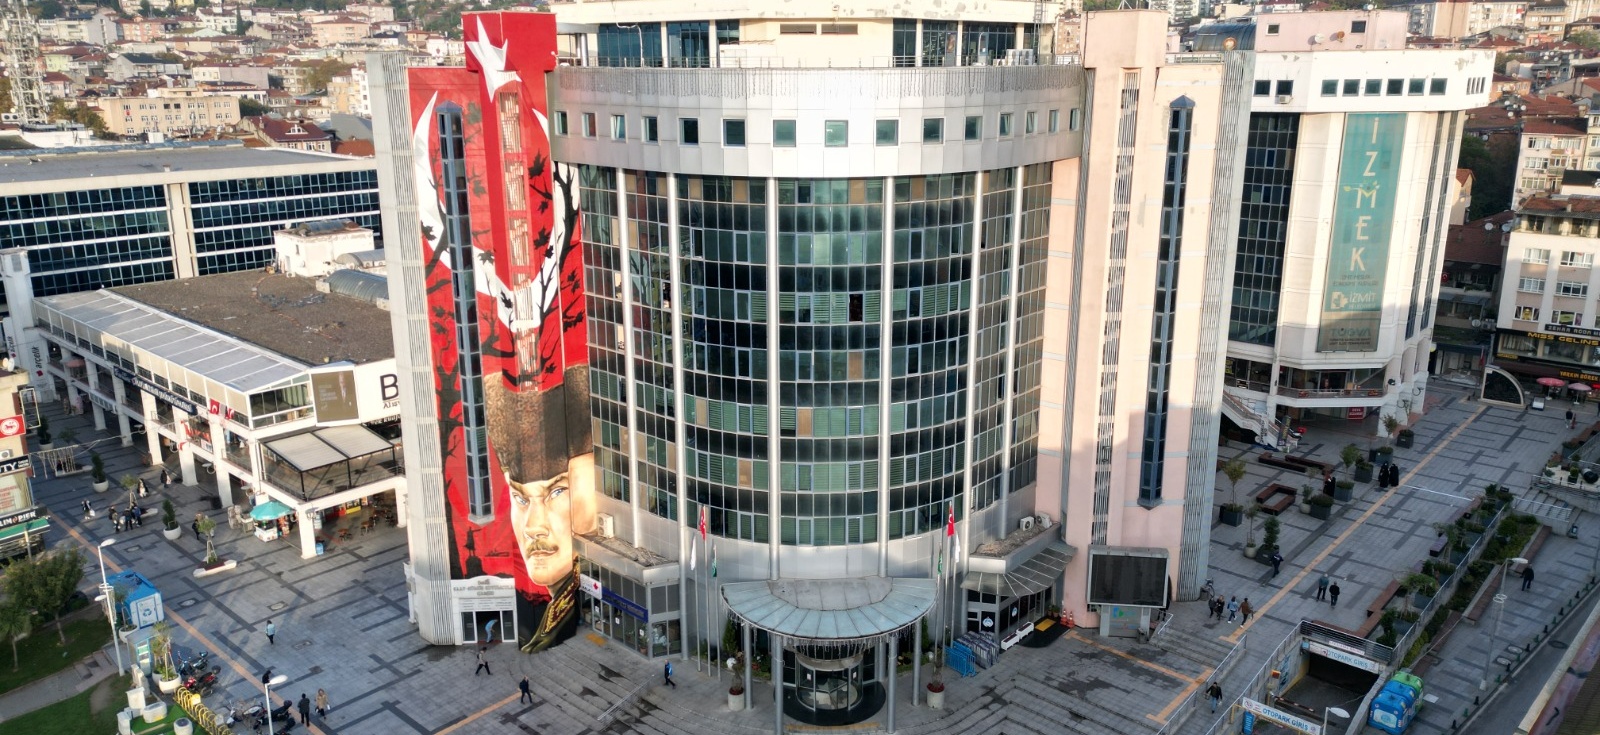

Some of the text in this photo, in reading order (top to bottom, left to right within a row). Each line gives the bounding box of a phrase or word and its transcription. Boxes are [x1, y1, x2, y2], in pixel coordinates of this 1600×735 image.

[1349, 290, 1376, 303] İZMİT
[1527, 332, 1554, 340] MISS
[31, 345, 43, 369] arçelik
[1262, 708, 1291, 723] OTOPARK
[1291, 718, 1309, 731] GİRİŞ
